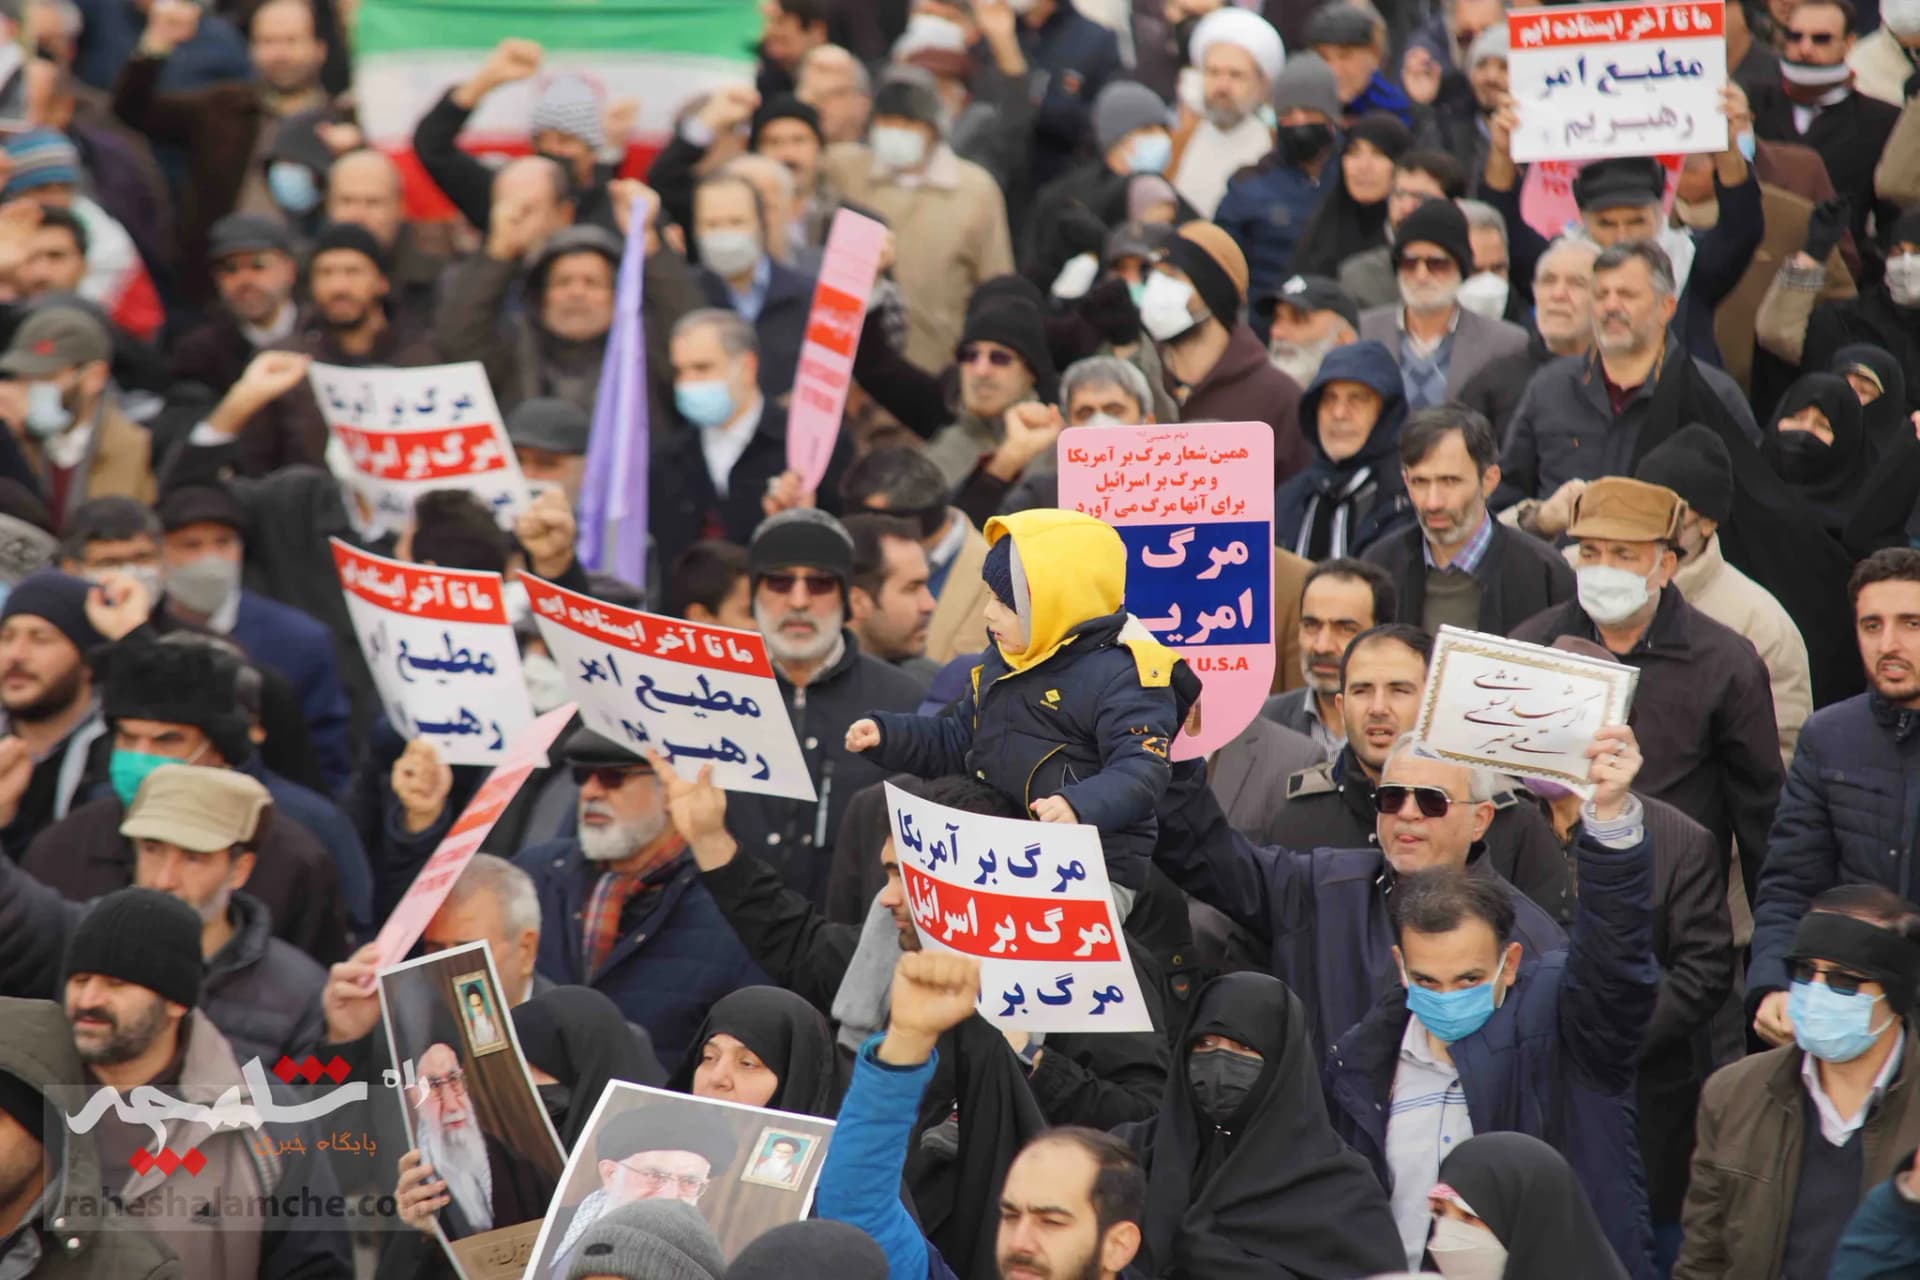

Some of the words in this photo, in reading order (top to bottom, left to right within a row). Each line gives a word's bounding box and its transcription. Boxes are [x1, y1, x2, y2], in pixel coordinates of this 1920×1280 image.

[1553, 11, 1625, 41] ایستاده
[1627, 7, 1670, 41] آخر
[1672, 6, 1689, 31] تا
[1692, 7, 1713, 30] ما
[1540, 56, 1587, 99] امر
[1597, 48, 1704, 95] مطیع
[1067, 446, 1116, 468] آمریکا
[1119, 450, 1133, 468] بر
[1136, 446, 1172, 466] مرگ
[1174, 445, 1208, 466] شعار
[1210, 446, 1250, 464] همین
[1095, 471, 1150, 492] اسرائیل
[1153, 475, 1167, 492] بر
[1170, 472, 1206, 490] مرگ
[1209, 476, 1218, 490] و
[1114, 502, 1138, 518] می
[1141, 498, 1177, 517] مرگ
[1180, 494, 1208, 514] آنها
[1211, 496, 1246, 516] برای
[1141, 526, 1249, 580] مرگ
[408, 575, 446, 612] آخر
[448, 580, 468, 609] تا
[469, 583, 493, 610] ما
[570, 608, 646, 647] ایستاده
[1137, 586, 1254, 644] امری
[655, 627, 697, 655] آخر
[703, 634, 724, 659] تا
[727, 637, 753, 664] ما
[397, 632, 495, 683] مطیع
[1197, 656, 1249, 671] U.S.A
[635, 674, 761, 718] مطیع
[897, 807, 960, 872] آمریکا
[973, 848, 997, 885] بر
[1007, 842, 1086, 893] مرگ
[910, 875, 979, 942] اسرائیل
[988, 913, 1019, 953] بر
[1025, 907, 1112, 957] مرگ
[998, 982, 1028, 1017] بر
[1036, 972, 1124, 1015] مرگ
